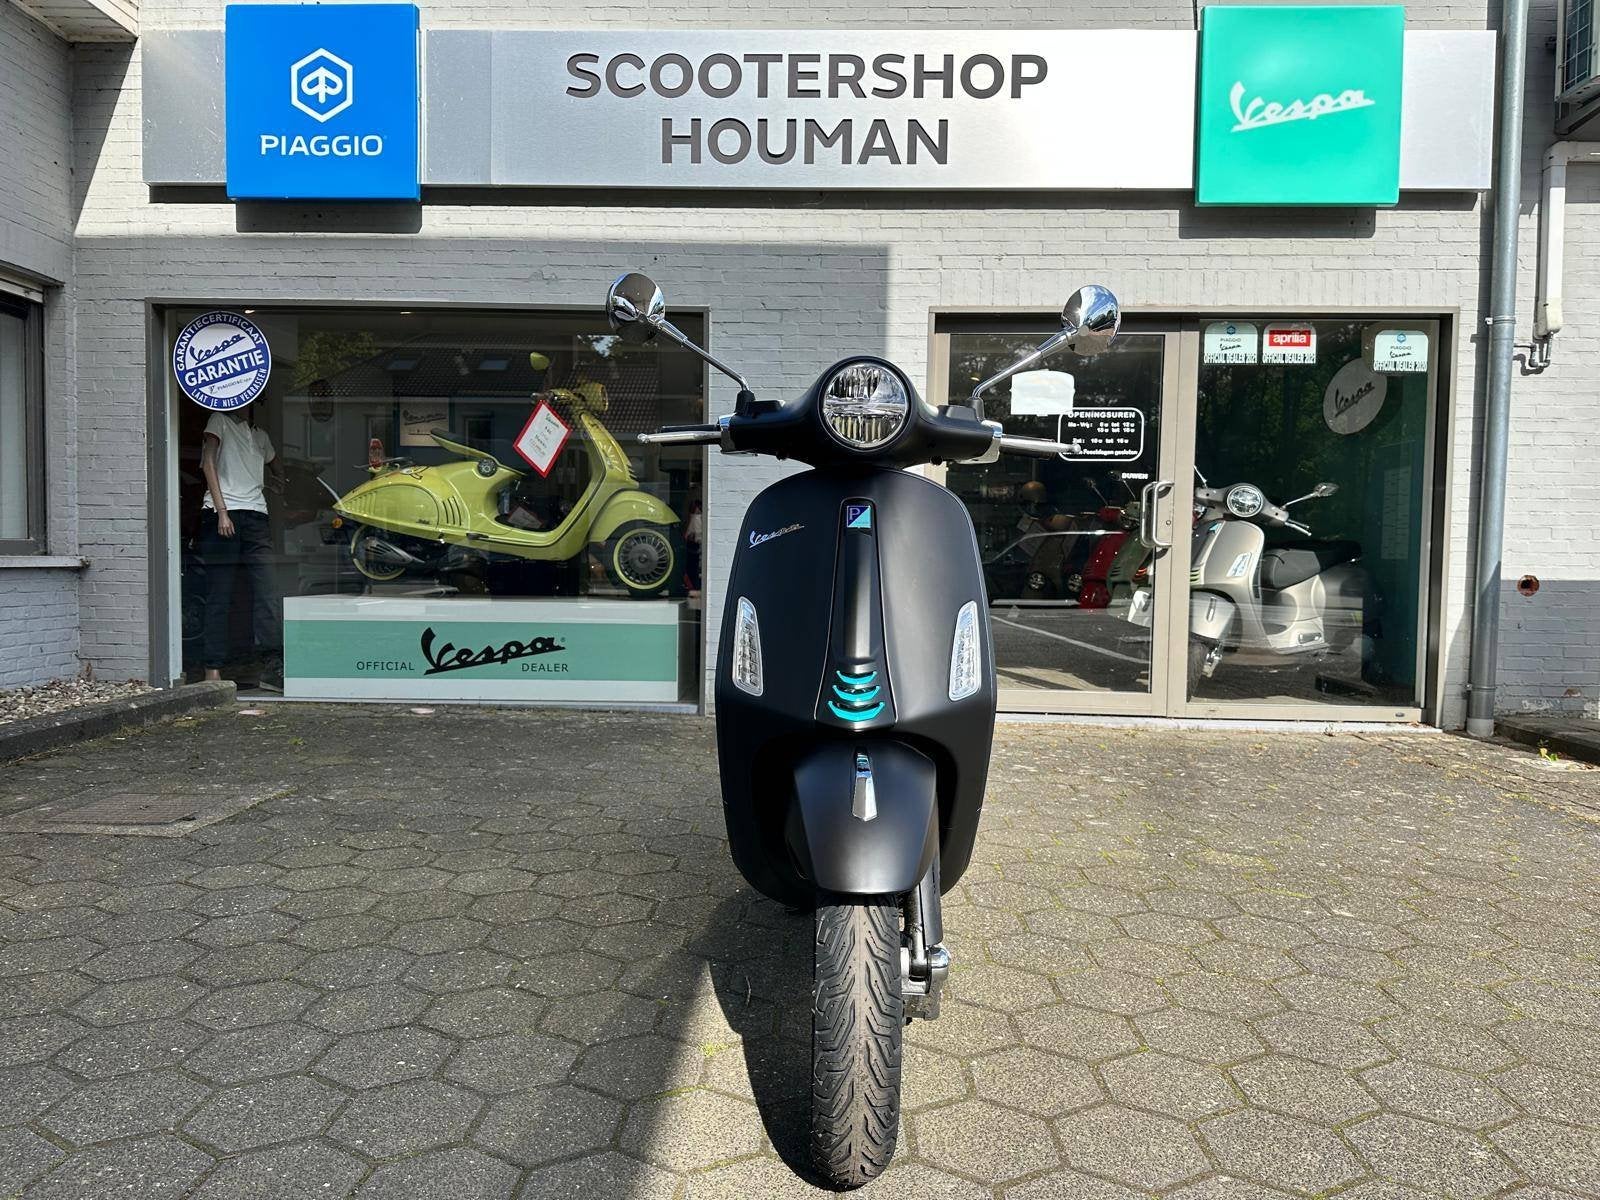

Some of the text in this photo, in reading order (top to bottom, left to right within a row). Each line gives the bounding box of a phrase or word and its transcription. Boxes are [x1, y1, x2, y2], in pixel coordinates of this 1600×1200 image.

[565, 53, 1048, 99] SCOOTERSHOP
[1229, 81, 1376, 133] Vespa
[260, 134, 383, 156] PIAGGIO
[661, 117, 948, 165] HOUMAN
[176, 313, 264, 372] GARANTIECERTIFICAAT
[189, 333, 247, 366] Vespa
[1273, 331, 1307, 345] aprilia
[184, 349, 265, 387] GARANTIE
[191, 388, 208, 403] LAAT
[209, 399, 218, 408] JE
[222, 397, 239, 408] NIET
[240, 367, 268, 402] VERRASSEN
[1333, 381, 1375, 418] Vespa
[748, 523, 805, 549] Vespa
[356, 626, 569, 676] OFFICIAL Vespa DEALER
